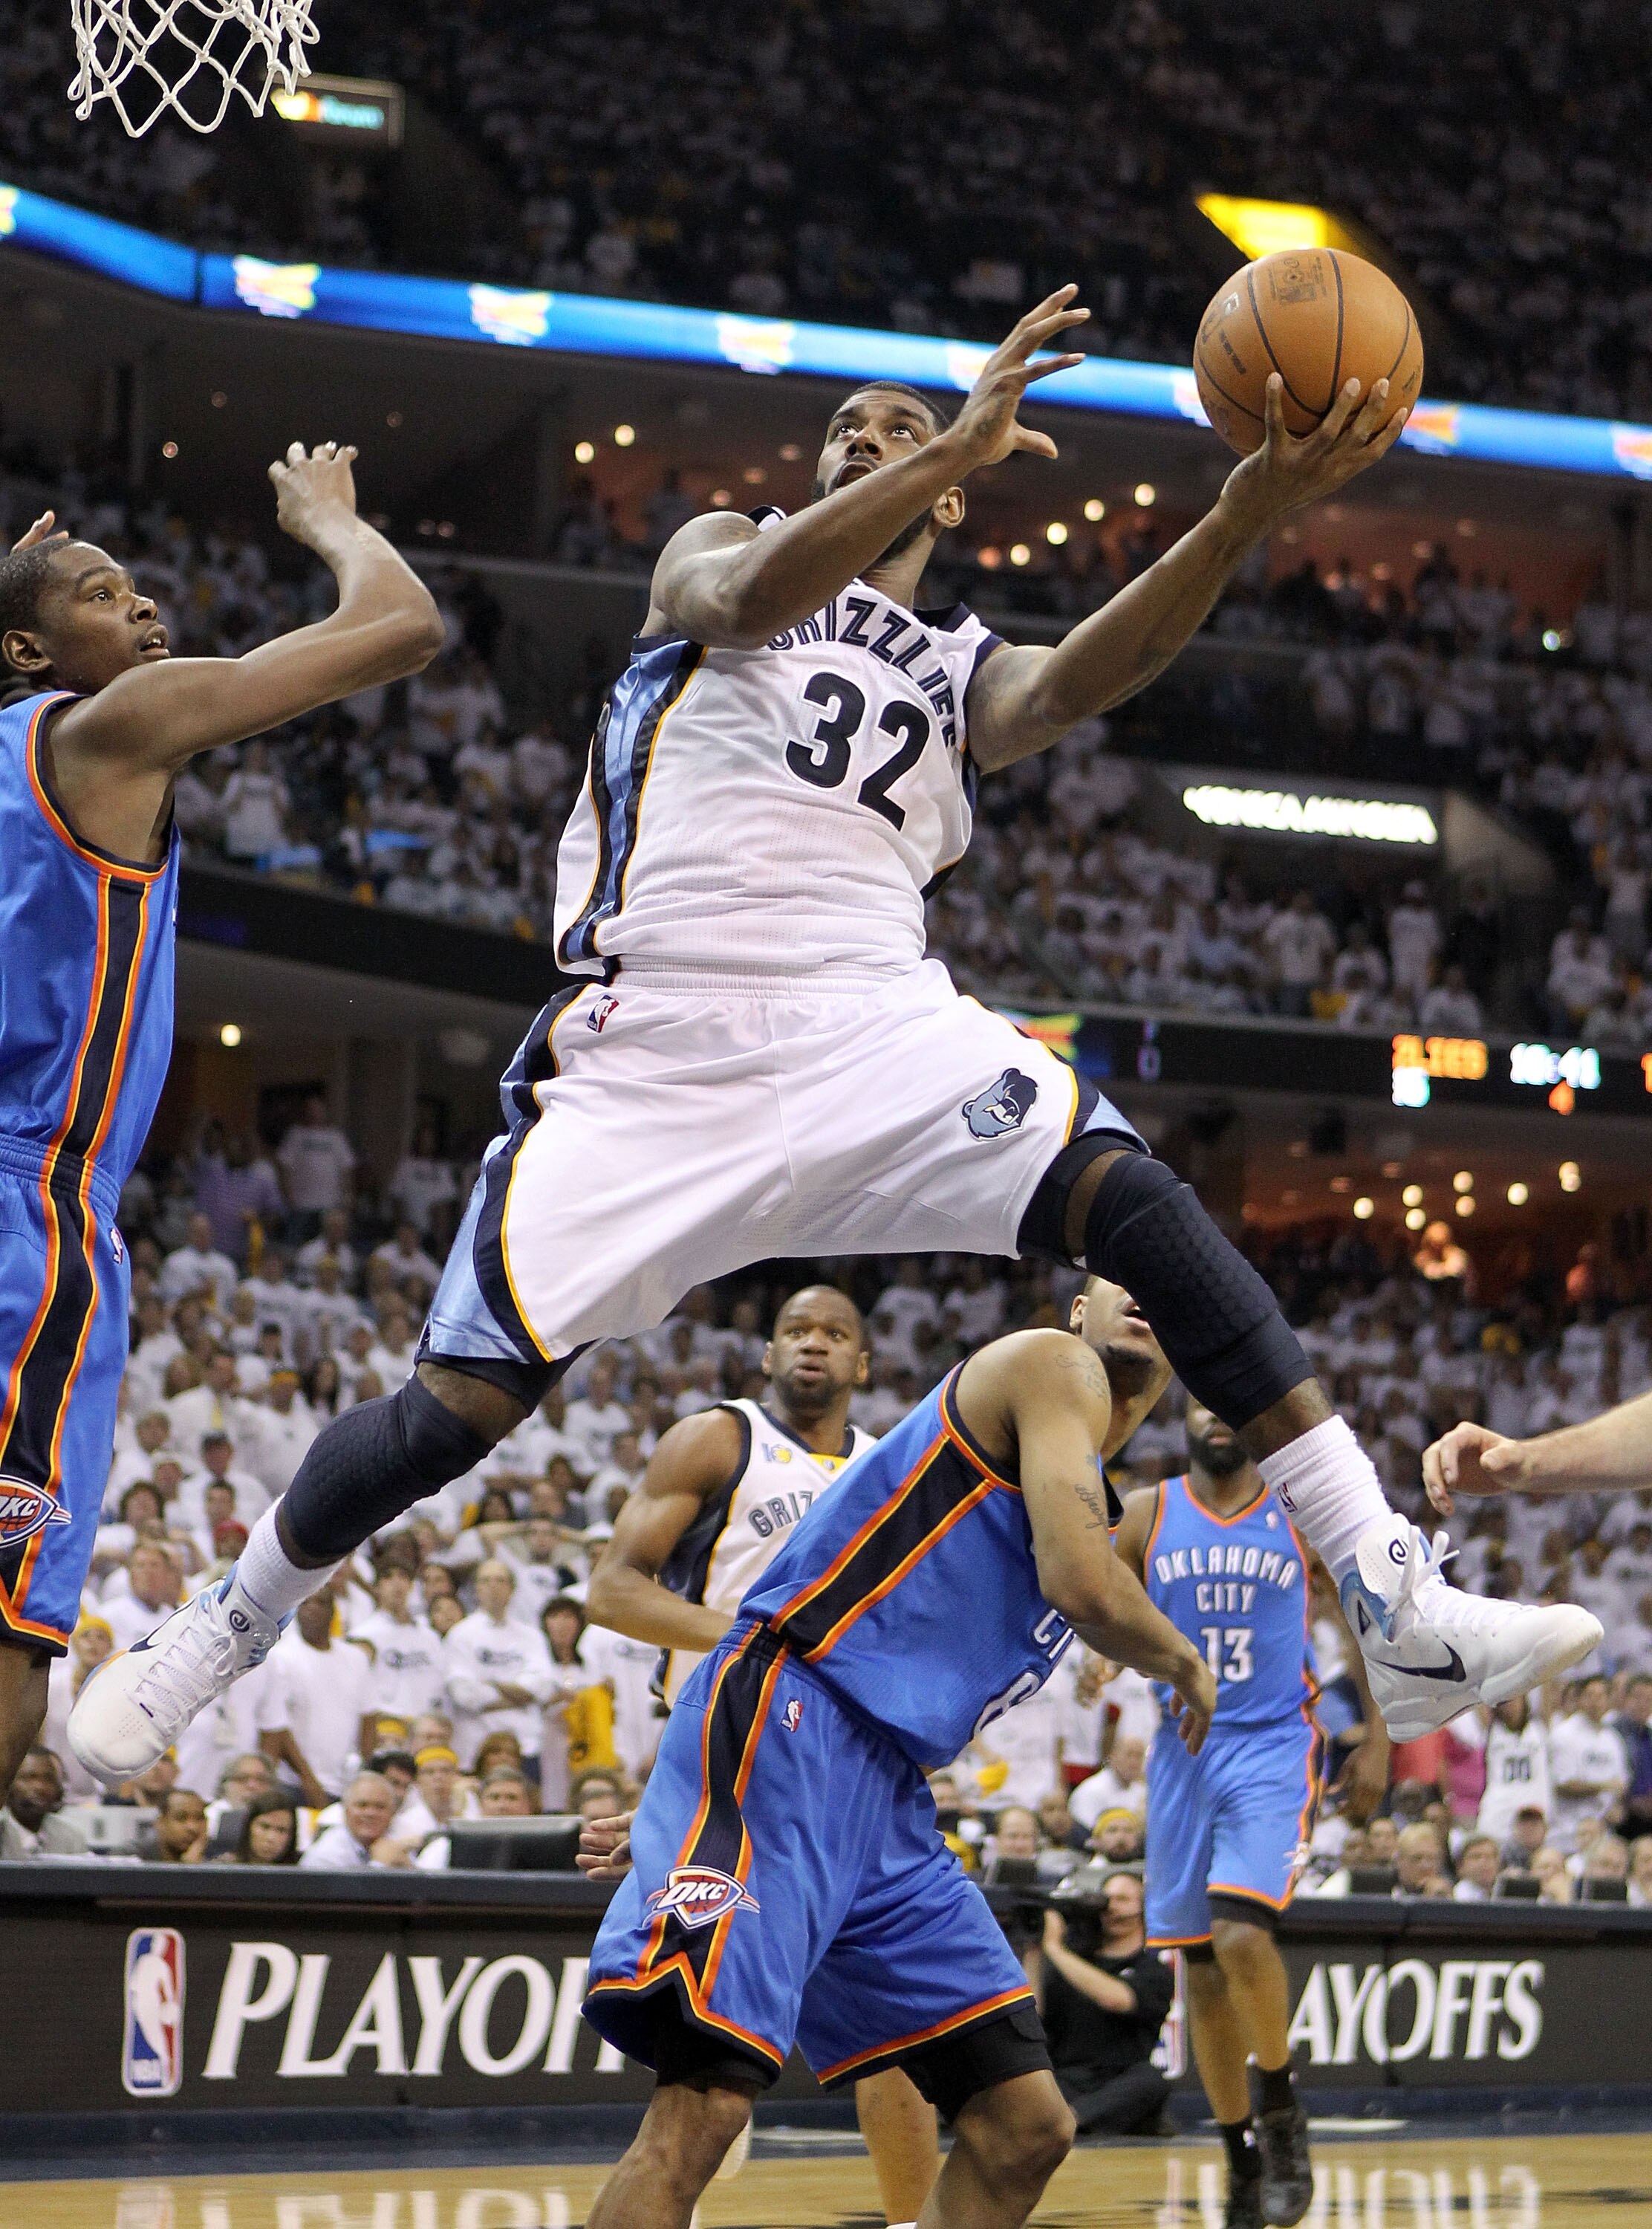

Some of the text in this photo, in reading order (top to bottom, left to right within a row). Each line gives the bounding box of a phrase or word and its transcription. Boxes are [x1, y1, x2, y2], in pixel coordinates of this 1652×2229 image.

[786, 672, 930, 832] 32
[1154, 1545, 1300, 1590] OKLAHOMA
[1196, 1582, 1257, 1614] CITY
[1200, 1626, 1253, 1683] 13
[656, 1881, 728, 1910] OKC
[201, 1941, 625, 2079] PLAYOF
